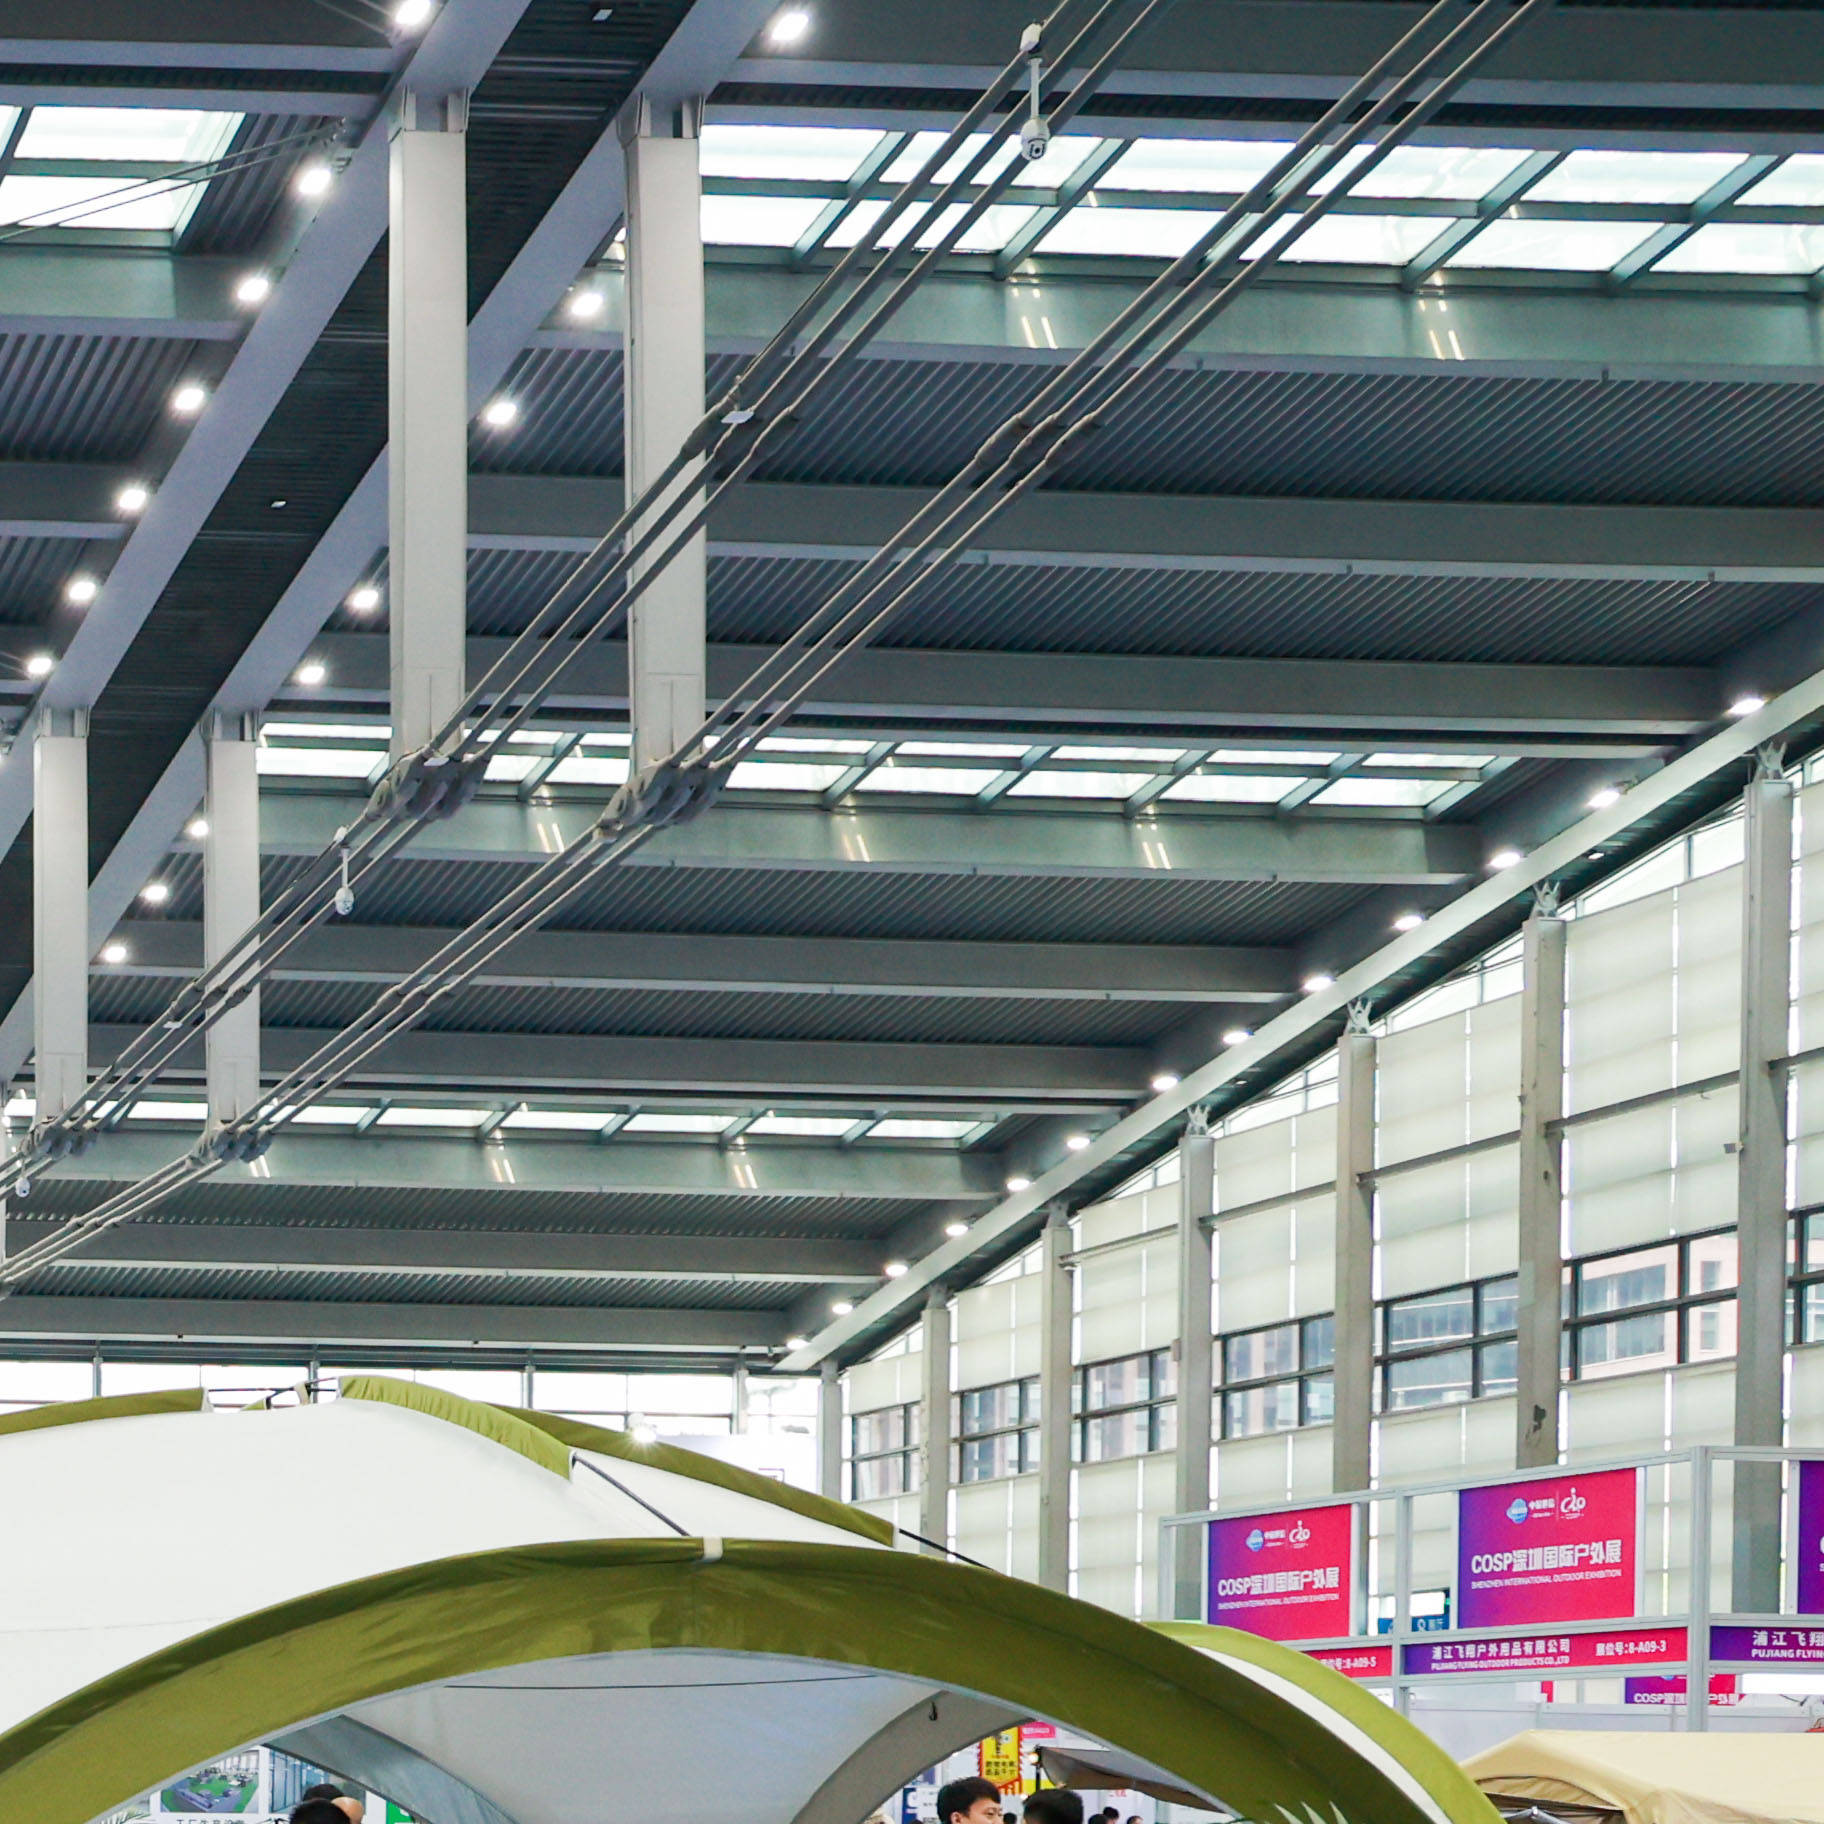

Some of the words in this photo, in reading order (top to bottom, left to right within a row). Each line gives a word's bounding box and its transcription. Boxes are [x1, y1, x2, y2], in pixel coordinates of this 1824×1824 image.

[1471, 1539, 1622, 1574] COSP深圳国际户外展
[1796, 1650, 1824, 1659] FLYIN
